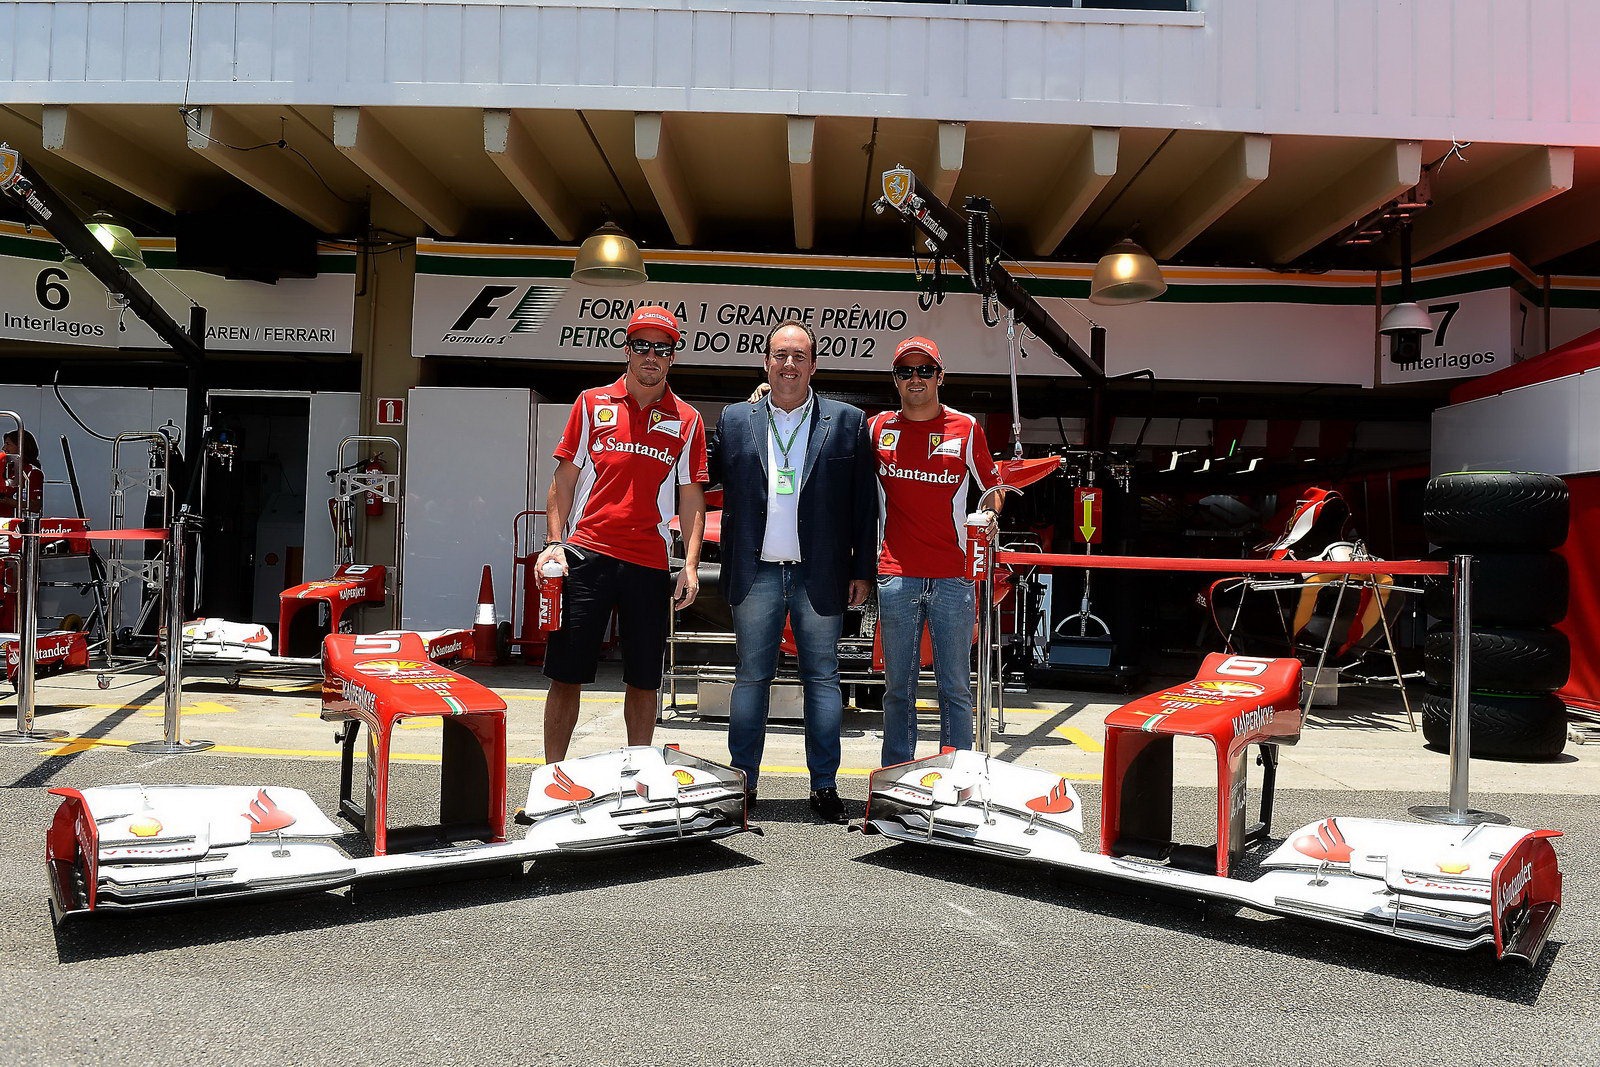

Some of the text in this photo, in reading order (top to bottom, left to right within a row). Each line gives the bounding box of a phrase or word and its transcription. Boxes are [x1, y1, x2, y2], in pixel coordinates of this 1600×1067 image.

[35, 267, 71, 311] 6
[4, 312, 105, 337] Interlagos
[644, 312, 674, 326] Santander
[700, 302, 707, 323] 1
[820, 304, 907, 331] PRÊMIO
[1428, 302, 1460, 346] 7
[264, 328, 336, 342] FERRARI
[441, 333, 495, 345] Formula
[693, 331, 730, 353] DO
[816, 336, 876, 358] 2012
[606, 437, 675, 466] Santander
[888, 464, 961, 484] Santander
[344, 564, 374, 575] 6
[973, 541, 985, 577] TNT
[539, 592, 549, 629] TNT
[353, 634, 401, 656] 5
[1216, 656, 1277, 677] 6
[413, 682, 452, 695] FIAT
[1161, 700, 1204, 710] FIAT
[1502, 857, 1532, 906] Santander
